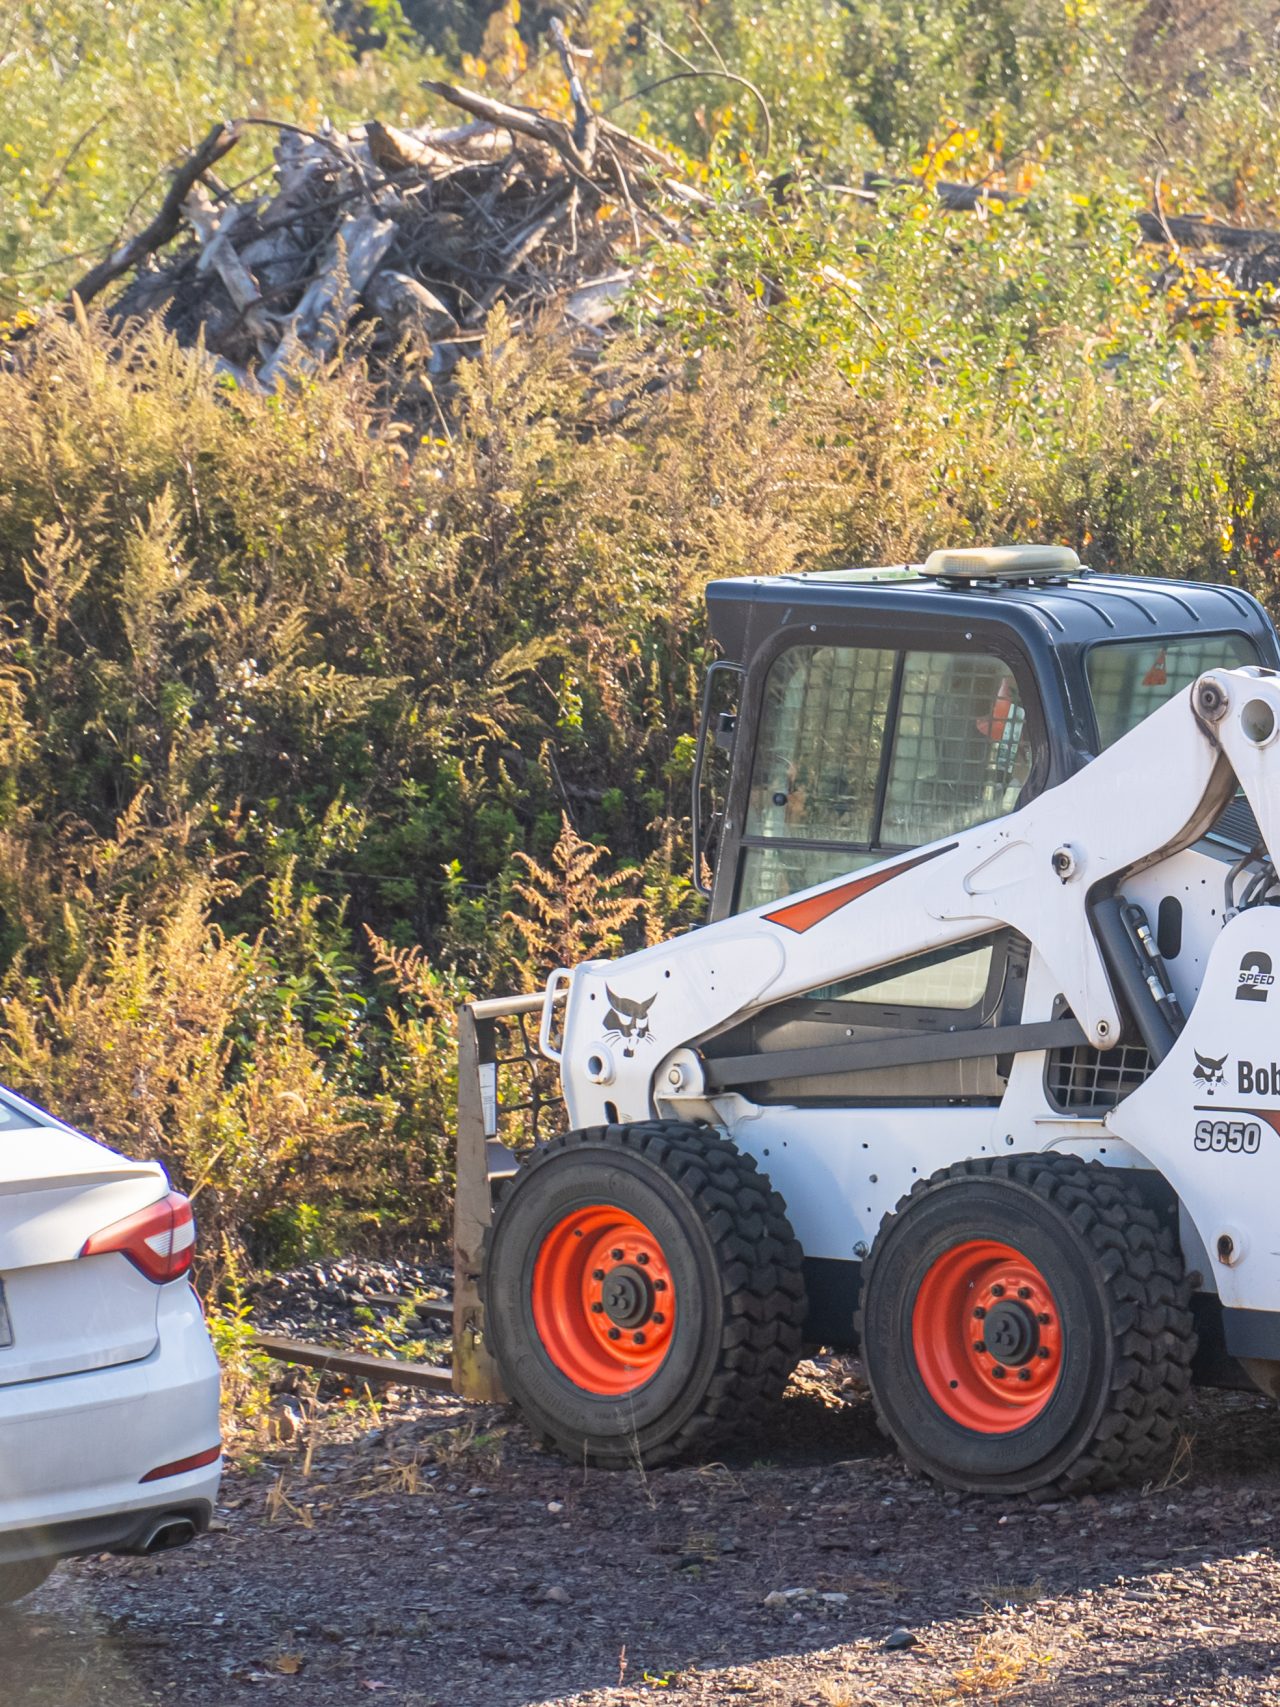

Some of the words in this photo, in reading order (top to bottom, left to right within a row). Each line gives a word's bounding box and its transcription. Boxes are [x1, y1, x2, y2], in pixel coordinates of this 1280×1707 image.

[1235, 951, 1273, 1002] 2
[1238, 973, 1275, 985] SPEED
[1194, 1120, 1261, 1155] S650
